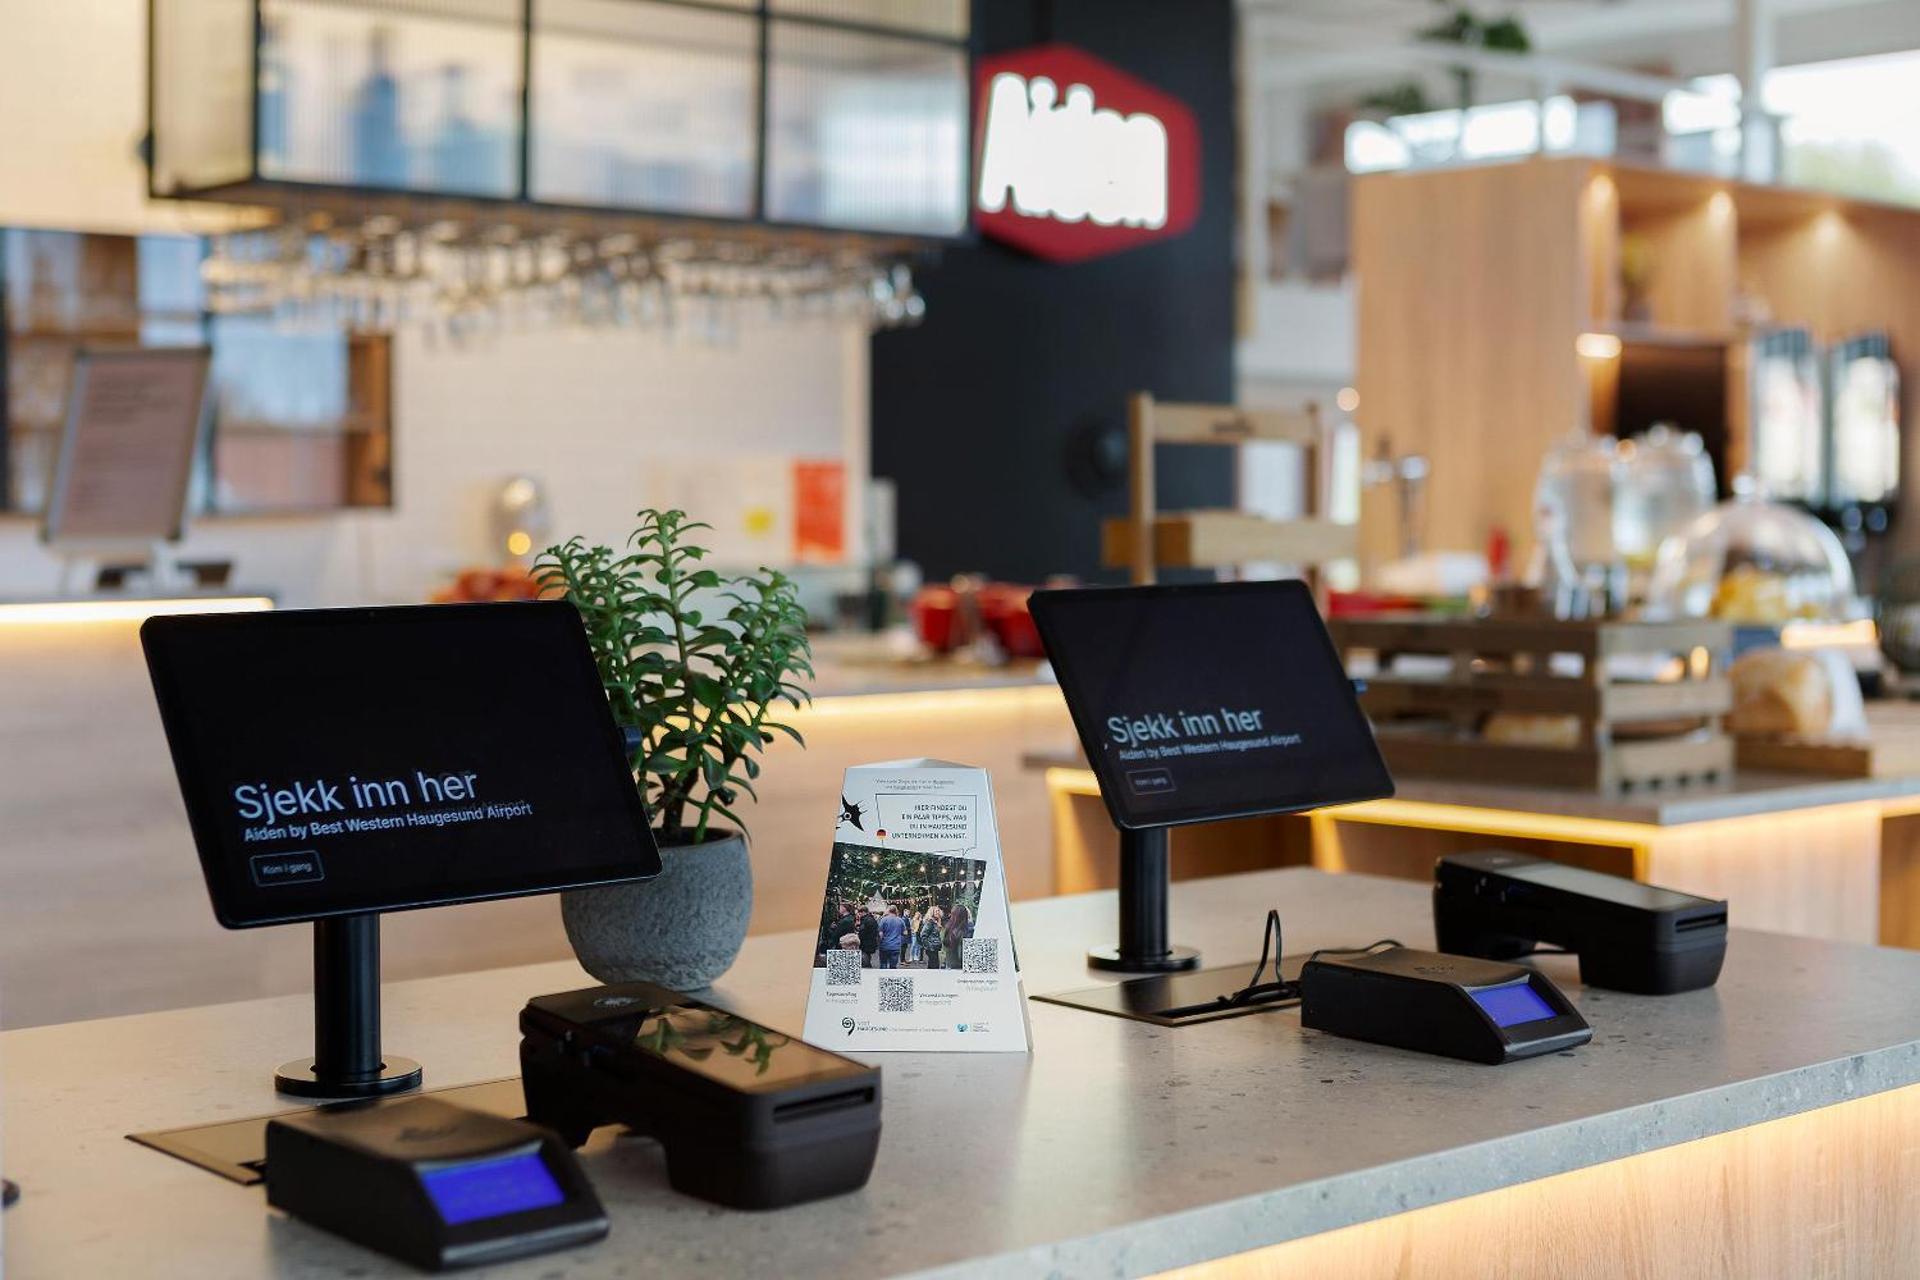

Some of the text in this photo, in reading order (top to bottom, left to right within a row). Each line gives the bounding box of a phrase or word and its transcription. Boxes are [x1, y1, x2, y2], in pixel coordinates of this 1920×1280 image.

[979, 72, 1168, 230] Aiden
[1108, 708, 1262, 747] Sjekk inn her
[1147, 747, 1159, 759] by
[1159, 745, 1182, 757] Best
[1182, 742, 1220, 755] Western
[1220, 737, 1270, 752] Haugesund
[234, 769, 478, 825] Sjekk inn her
[243, 801, 534, 843] Aiden by Best Western Haugesund Airport
